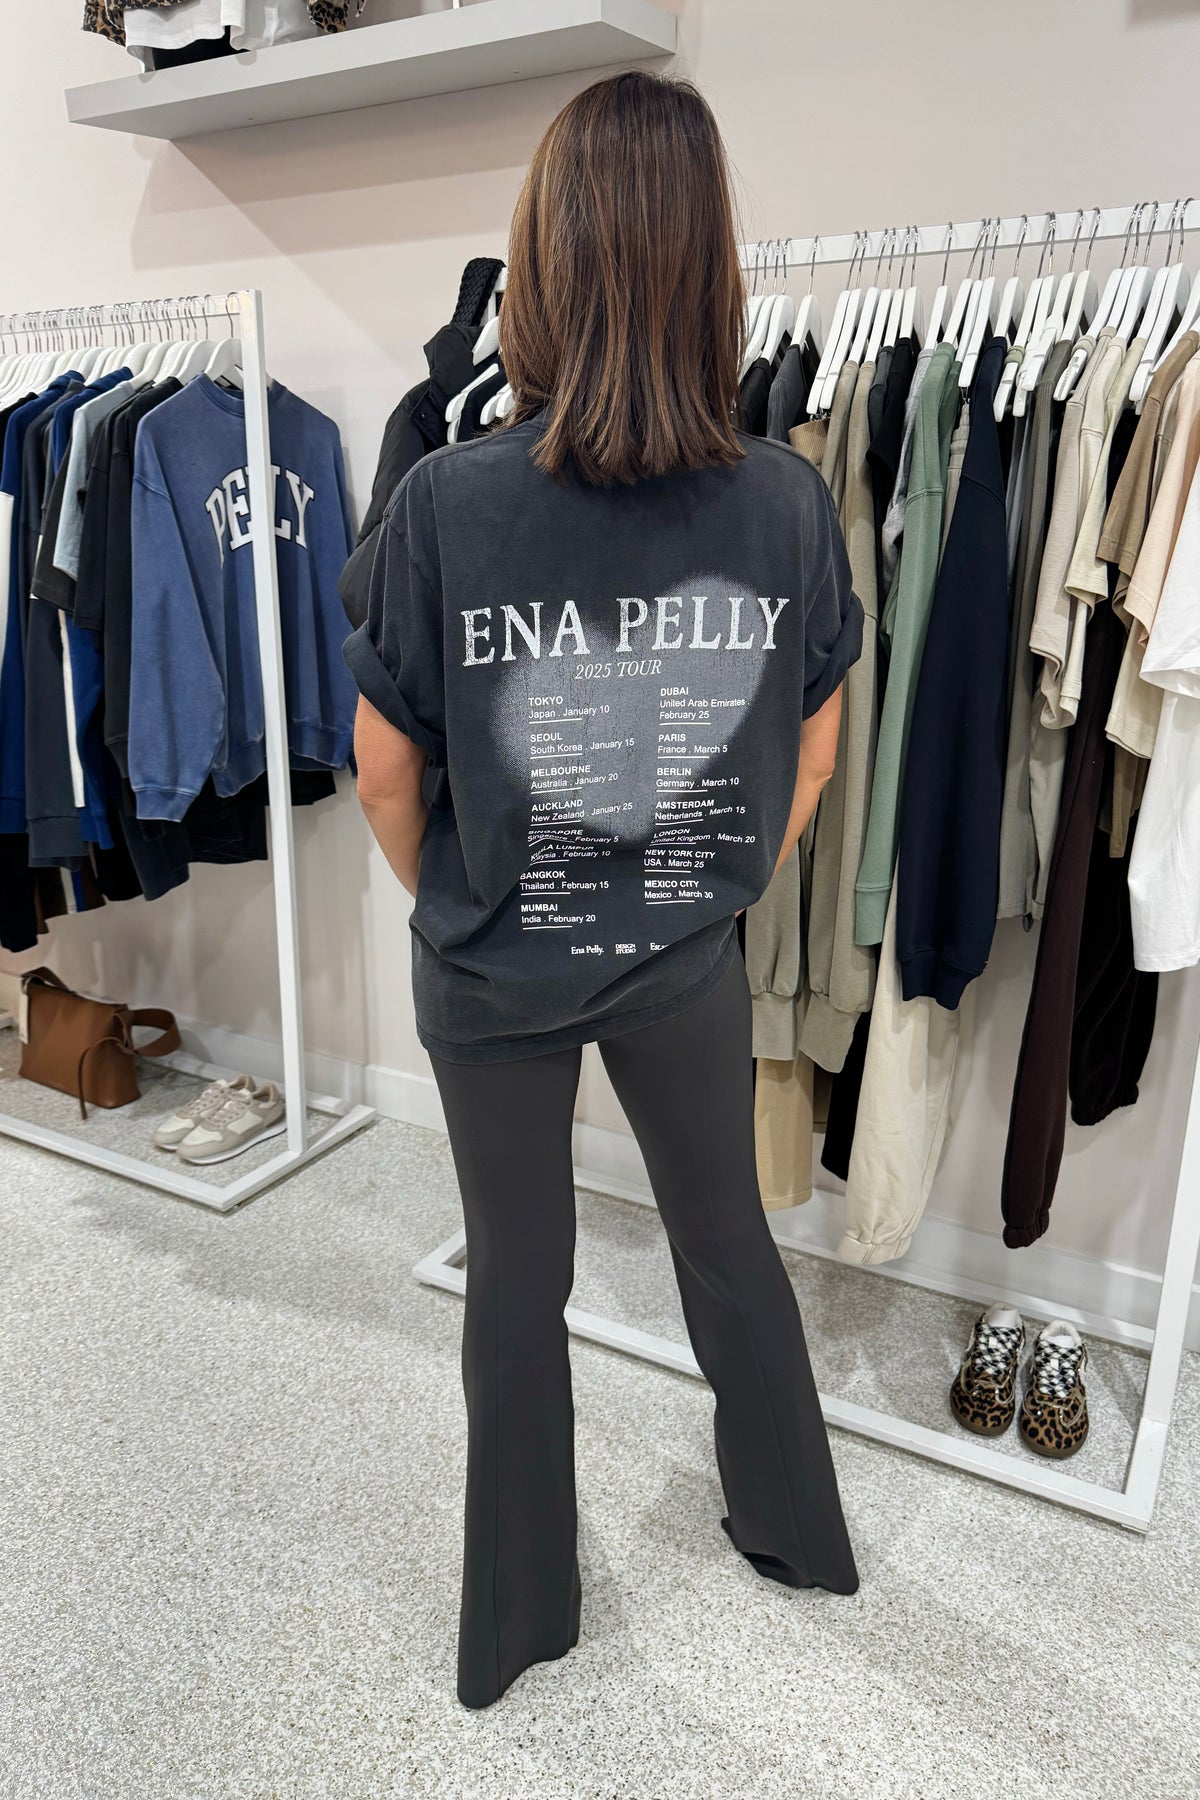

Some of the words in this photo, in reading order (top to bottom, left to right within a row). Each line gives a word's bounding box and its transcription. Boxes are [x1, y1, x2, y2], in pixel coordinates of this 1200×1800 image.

[205, 464, 315, 566] PELY
[460, 600, 591, 667] ENA
[615, 596, 790, 652] PELLY
[575, 663, 612, 680] 2025
[617, 660, 662, 677] TOUR
[660, 687, 689, 696] DUBAI
[528, 695, 564, 706] TOKYO
[660, 699, 686, 708] United
[688, 699, 708, 707] Arab
[711, 698, 745, 707] Emirates
[529, 710, 556, 720] Japan
[563, 707, 597, 717] January
[600, 705, 610, 713] 10
[660, 711, 696, 720] February
[530, 733, 563, 742] SEOUL
[658, 734, 686, 742] PARIS
[530, 745, 555, 755] South
[558, 743, 583, 752] Korea
[590, 741, 622, 750] January
[625, 738, 635, 747] 15
[694, 745, 720, 753] March
[531, 765, 591, 777] MELBOURNE
[657, 768, 691, 776] BERLIN
[530, 780, 568, 789] Australia
[574, 776, 606, 785] January
[608, 772, 619, 781] 20
[656, 779, 695, 789] Germany
[701, 778, 727, 787] March
[729, 777, 740, 785] 10
[531, 799, 583, 812] AUCKLAND
[655, 800, 715, 809] AMSTERDAM
[552, 810, 585, 821] Zealand
[591, 805, 621, 816] January
[622, 802, 633, 811] 25
[655, 810, 703, 820] Netherlands
[709, 806, 733, 816] March
[735, 806, 746, 814] 15
[653, 828, 691, 838] LONDON
[677, 834, 711, 842] Kingdom
[718, 832, 743, 843] March
[745, 835, 756, 843] 20
[563, 850, 598, 858] February
[695, 851, 715, 859] CITY
[668, 859, 692, 867] March
[520, 871, 566, 880] BANGKOK
[520, 882, 555, 890] Thailand
[561, 881, 597, 890] February
[599, 881, 609, 889] 15
[644, 880, 678, 888] MEXICO
[644, 891, 672, 899] Mexico
[678, 890, 702, 898] March
[704, 891, 714, 899] 30
[521, 904, 558, 912] MUMBAI
[521, 915, 541, 924] India
[548, 914, 584, 924] February
[585, 914, 596, 922] 20
[570, 946, 585, 955] Ena
